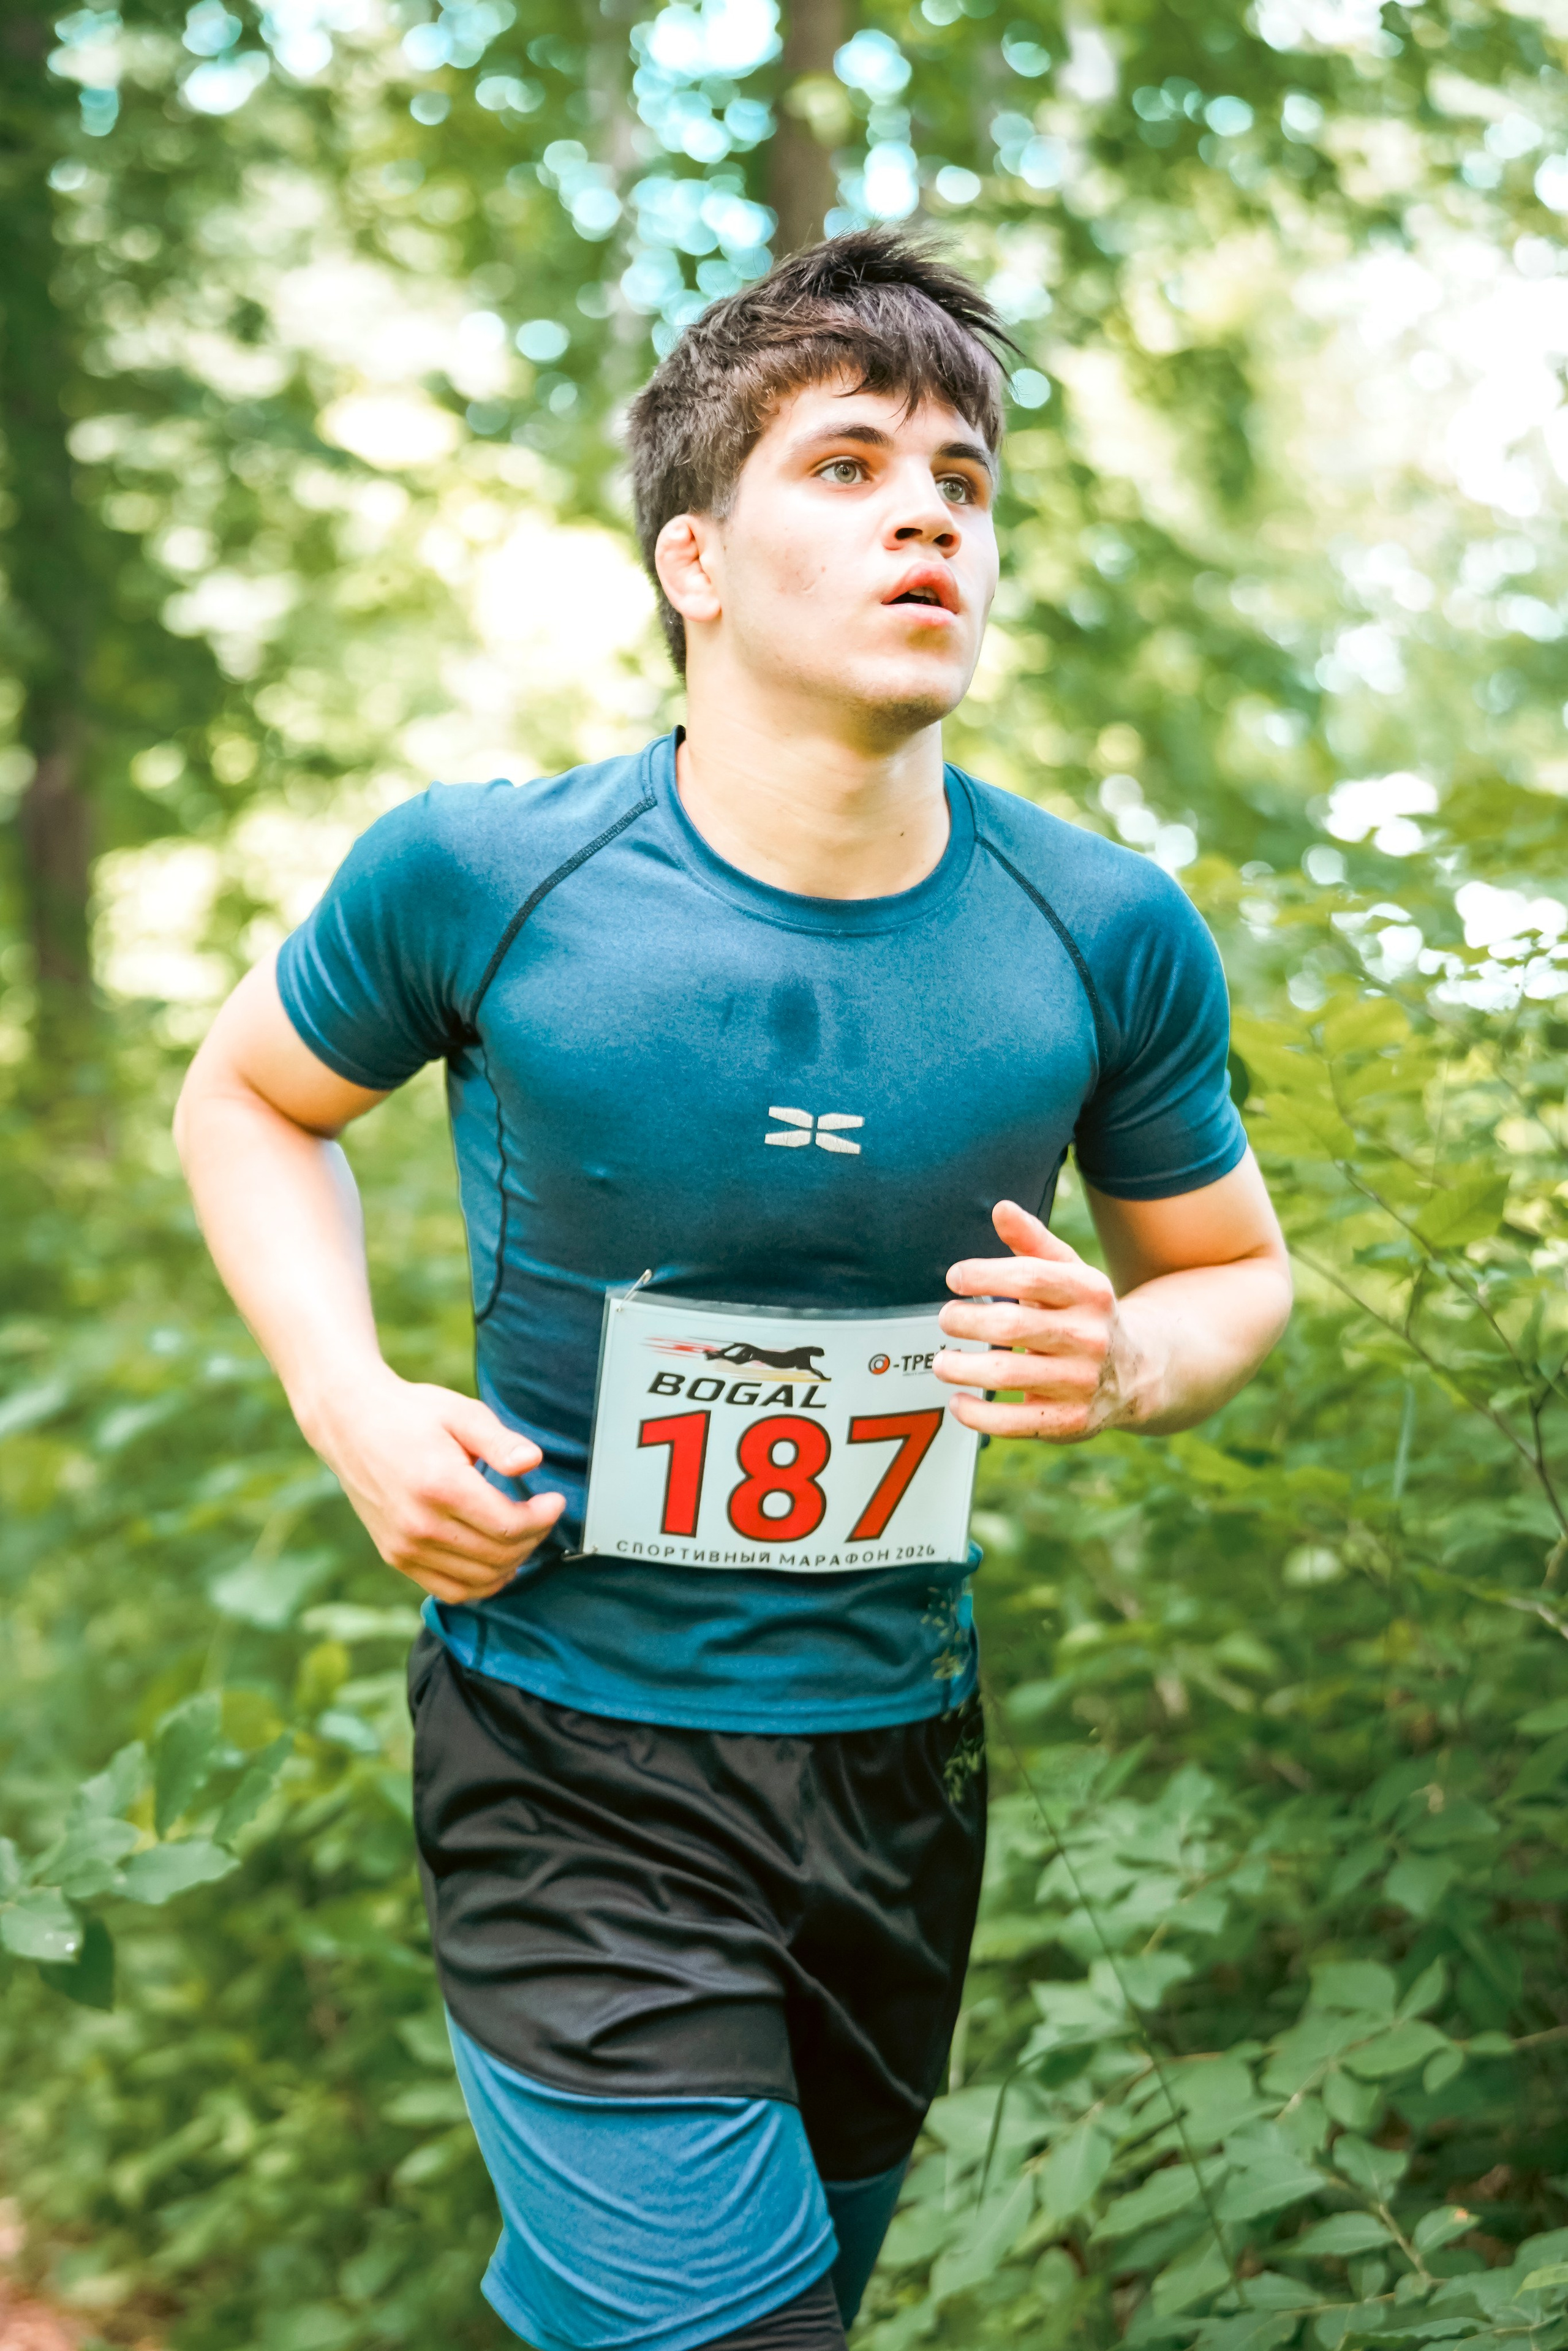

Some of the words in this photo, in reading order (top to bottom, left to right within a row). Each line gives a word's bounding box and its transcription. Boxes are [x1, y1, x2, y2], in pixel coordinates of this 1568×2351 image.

[647, 1372, 827, 1408] BOGAL
[637, 1406, 945, 1543] 187
[779, 1549, 889, 1566] МАРАФОН
[896, 1544, 935, 1560] 2026
